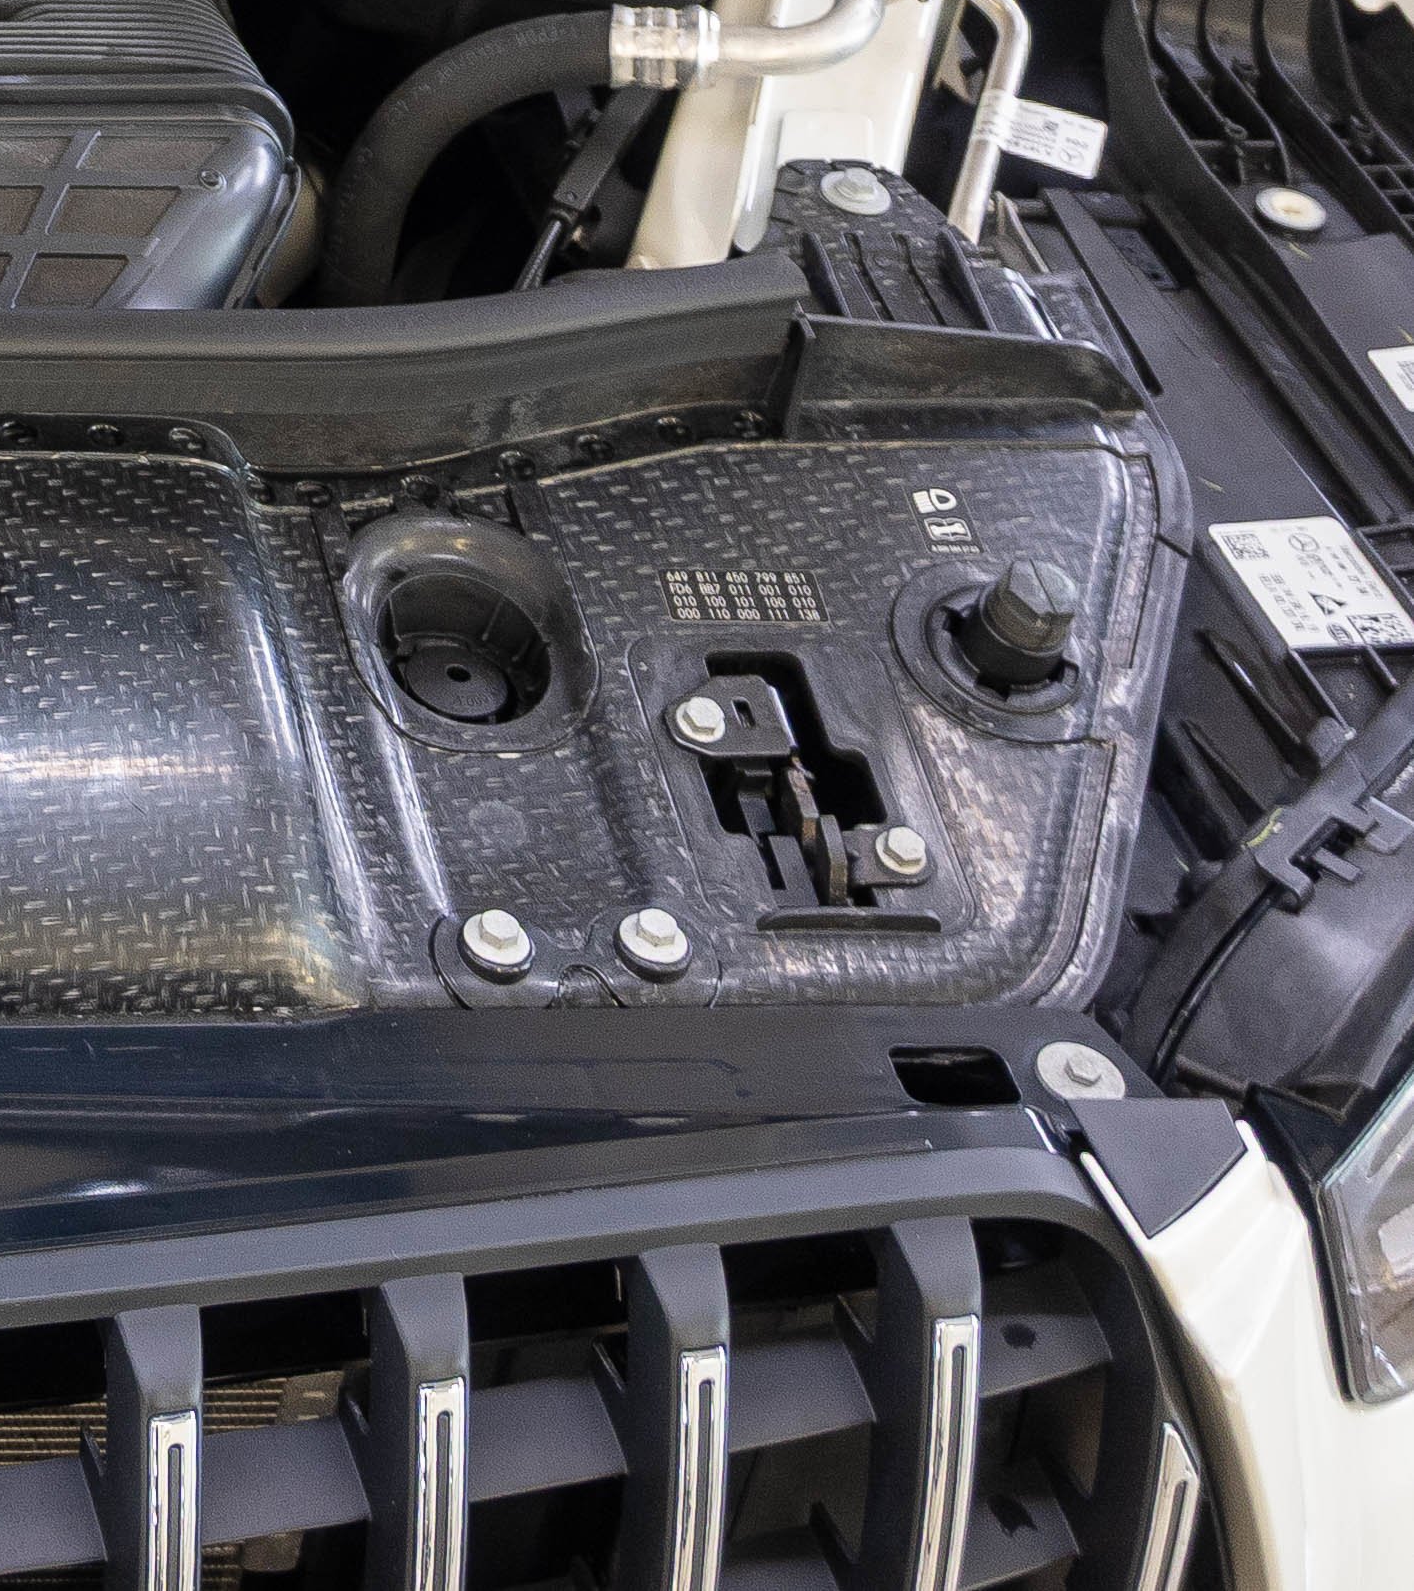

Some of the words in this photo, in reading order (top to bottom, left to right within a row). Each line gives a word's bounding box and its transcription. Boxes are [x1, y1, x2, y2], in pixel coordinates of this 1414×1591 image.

[666, 571, 688, 582] 649
[728, 584, 751, 596] 011
[759, 584, 782, 596] 001
[788, 584, 812, 596] 010
[673, 595, 697, 607] 010
[704, 596, 727, 608] 100
[734, 596, 756, 608] 101
[764, 597, 786, 609] 100
[793, 597, 817, 609] 010
[677, 607, 700, 619] 000
[708, 608, 731, 619] 110
[738, 608, 761, 620] 000
[768, 609, 790, 620] 111
